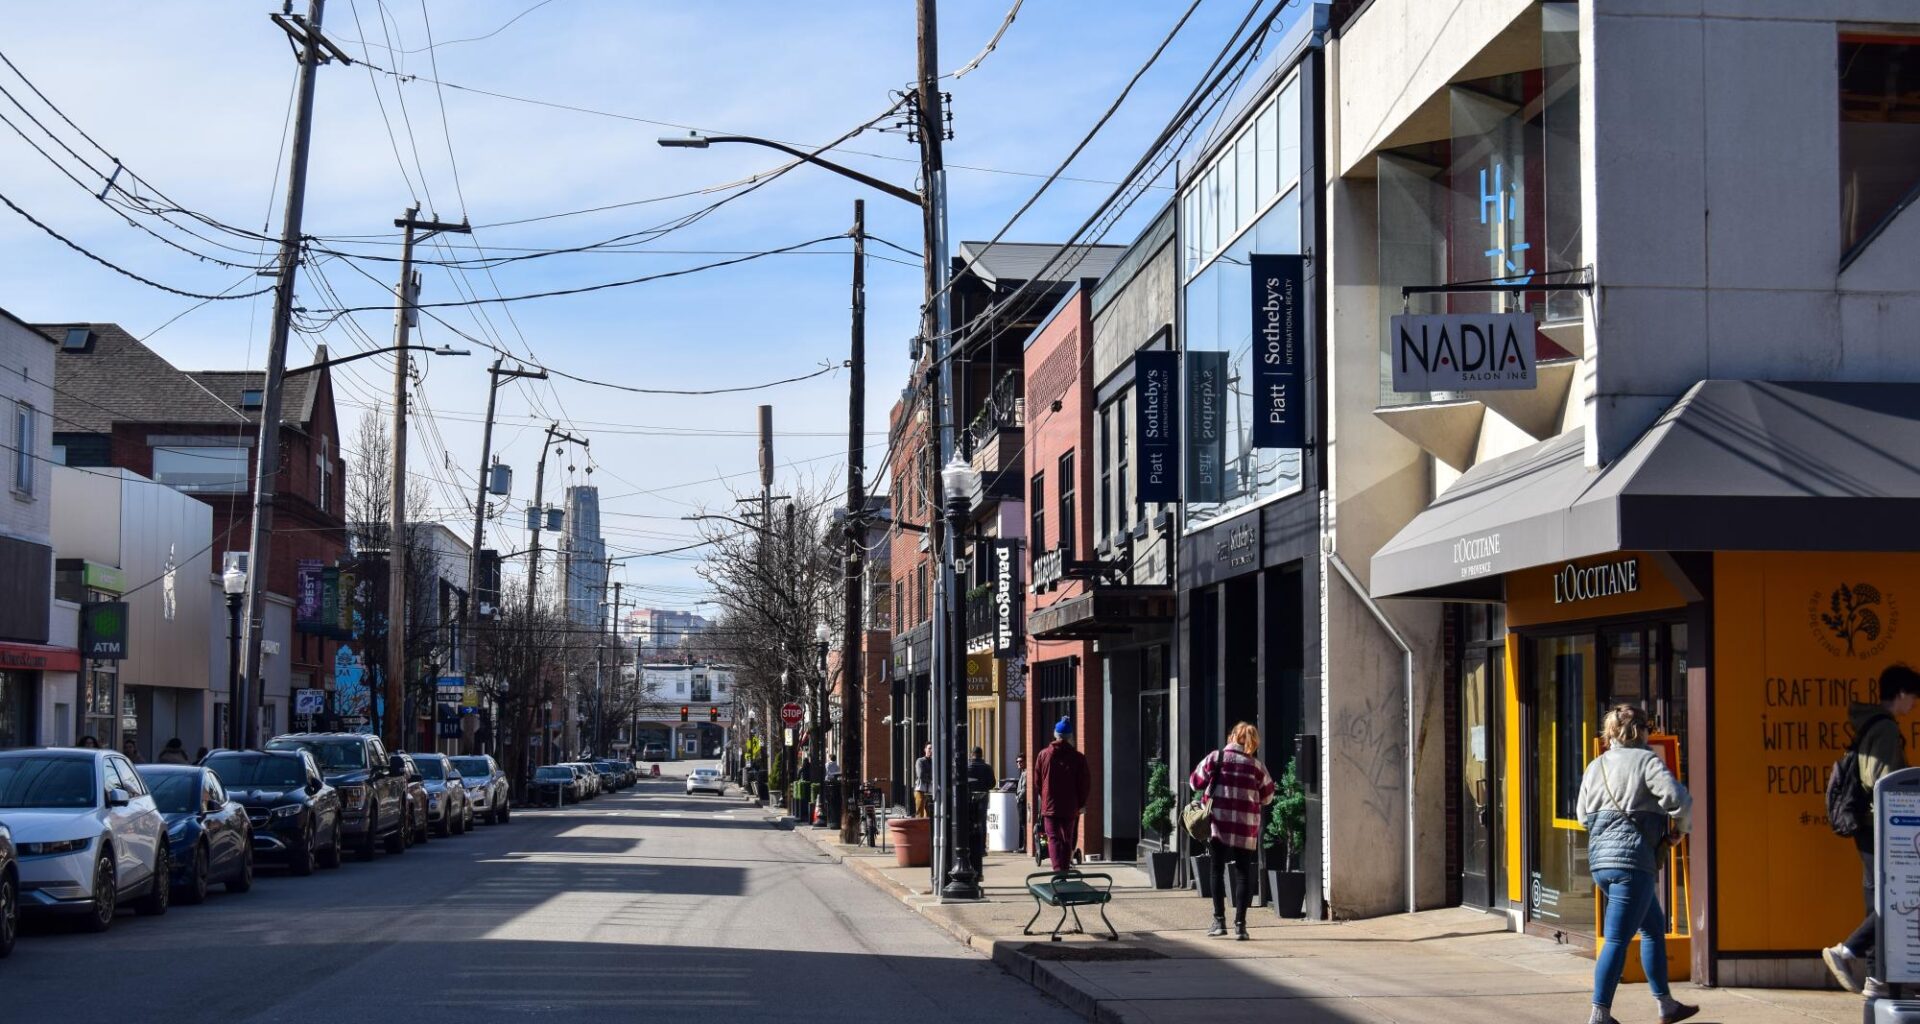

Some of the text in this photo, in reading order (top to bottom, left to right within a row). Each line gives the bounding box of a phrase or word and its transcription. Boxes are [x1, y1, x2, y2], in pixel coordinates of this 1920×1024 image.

[1479, 164, 1517, 224] Hi
[1262, 277, 1285, 424] Piatt Sotheby's
[1400, 322, 1526, 373] NADIA
[1462, 372, 1500, 381] SALON
[1145, 369, 1163, 484] Piatt Sotheby's
[305, 574, 314, 605] BEST
[996, 547, 1010, 650] patagonia
[1553, 560, 1636, 604] L'OCCITANE
[93, 642, 120, 652] ATM
[1765, 678, 1858, 707] CRAFTING
[444, 723, 459, 733] GAP
[783, 709, 802, 718] STOP
